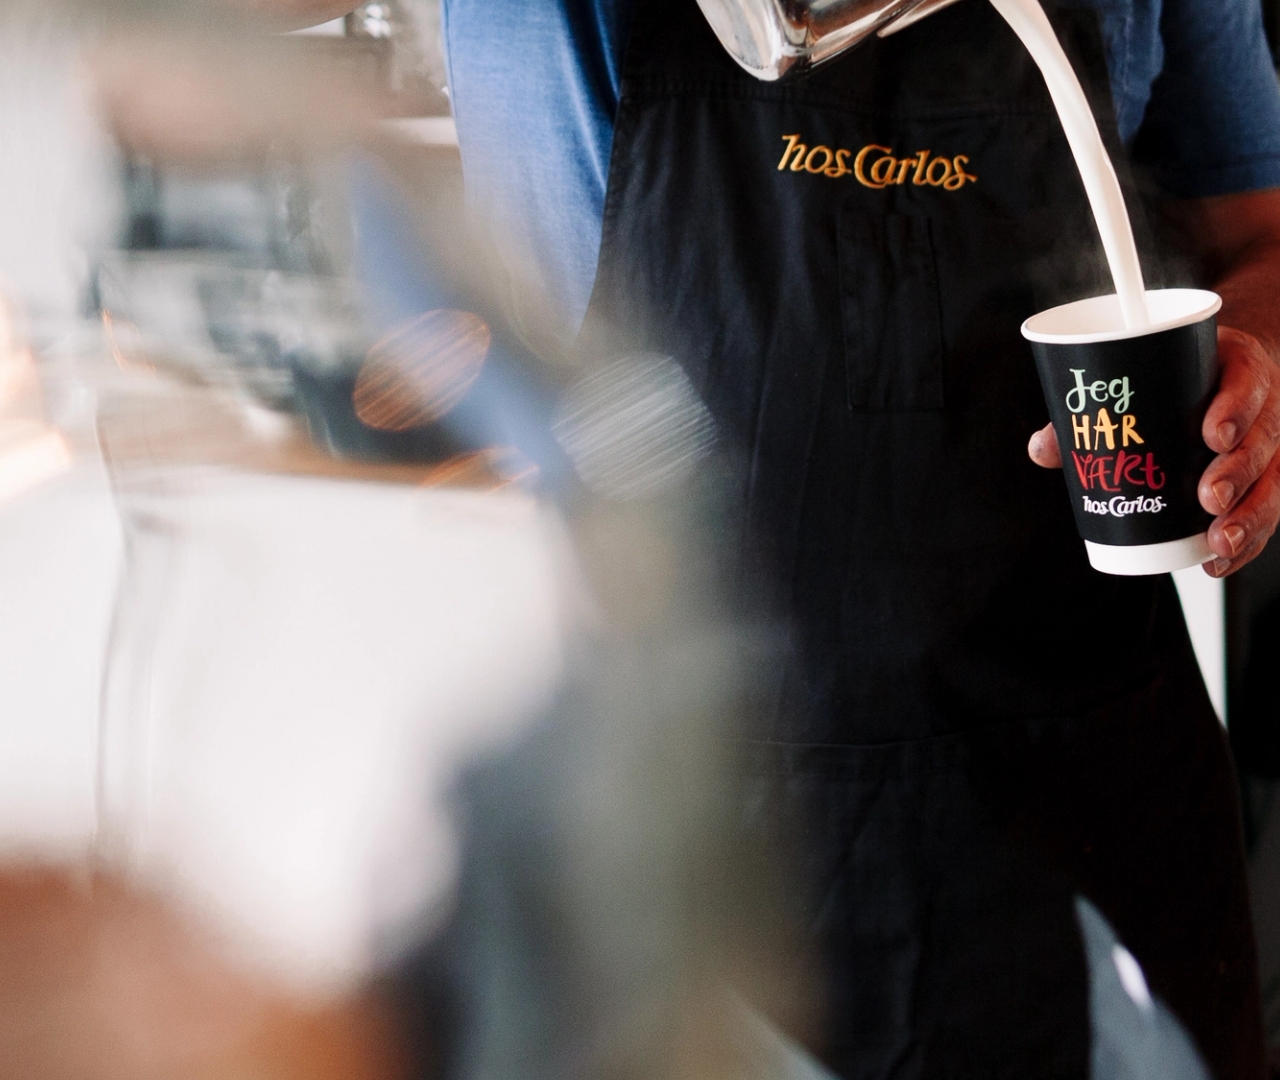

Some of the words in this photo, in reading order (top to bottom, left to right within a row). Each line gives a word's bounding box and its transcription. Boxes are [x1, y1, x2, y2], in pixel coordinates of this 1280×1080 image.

[777, 133, 852, 178] hos
[854, 143, 978, 191] Carlos
[1065, 368, 1135, 414] Jeg
[1071, 407, 1145, 451] HAR
[1082, 495, 1109, 515] hos
[1108, 495, 1167, 517] Carlos
